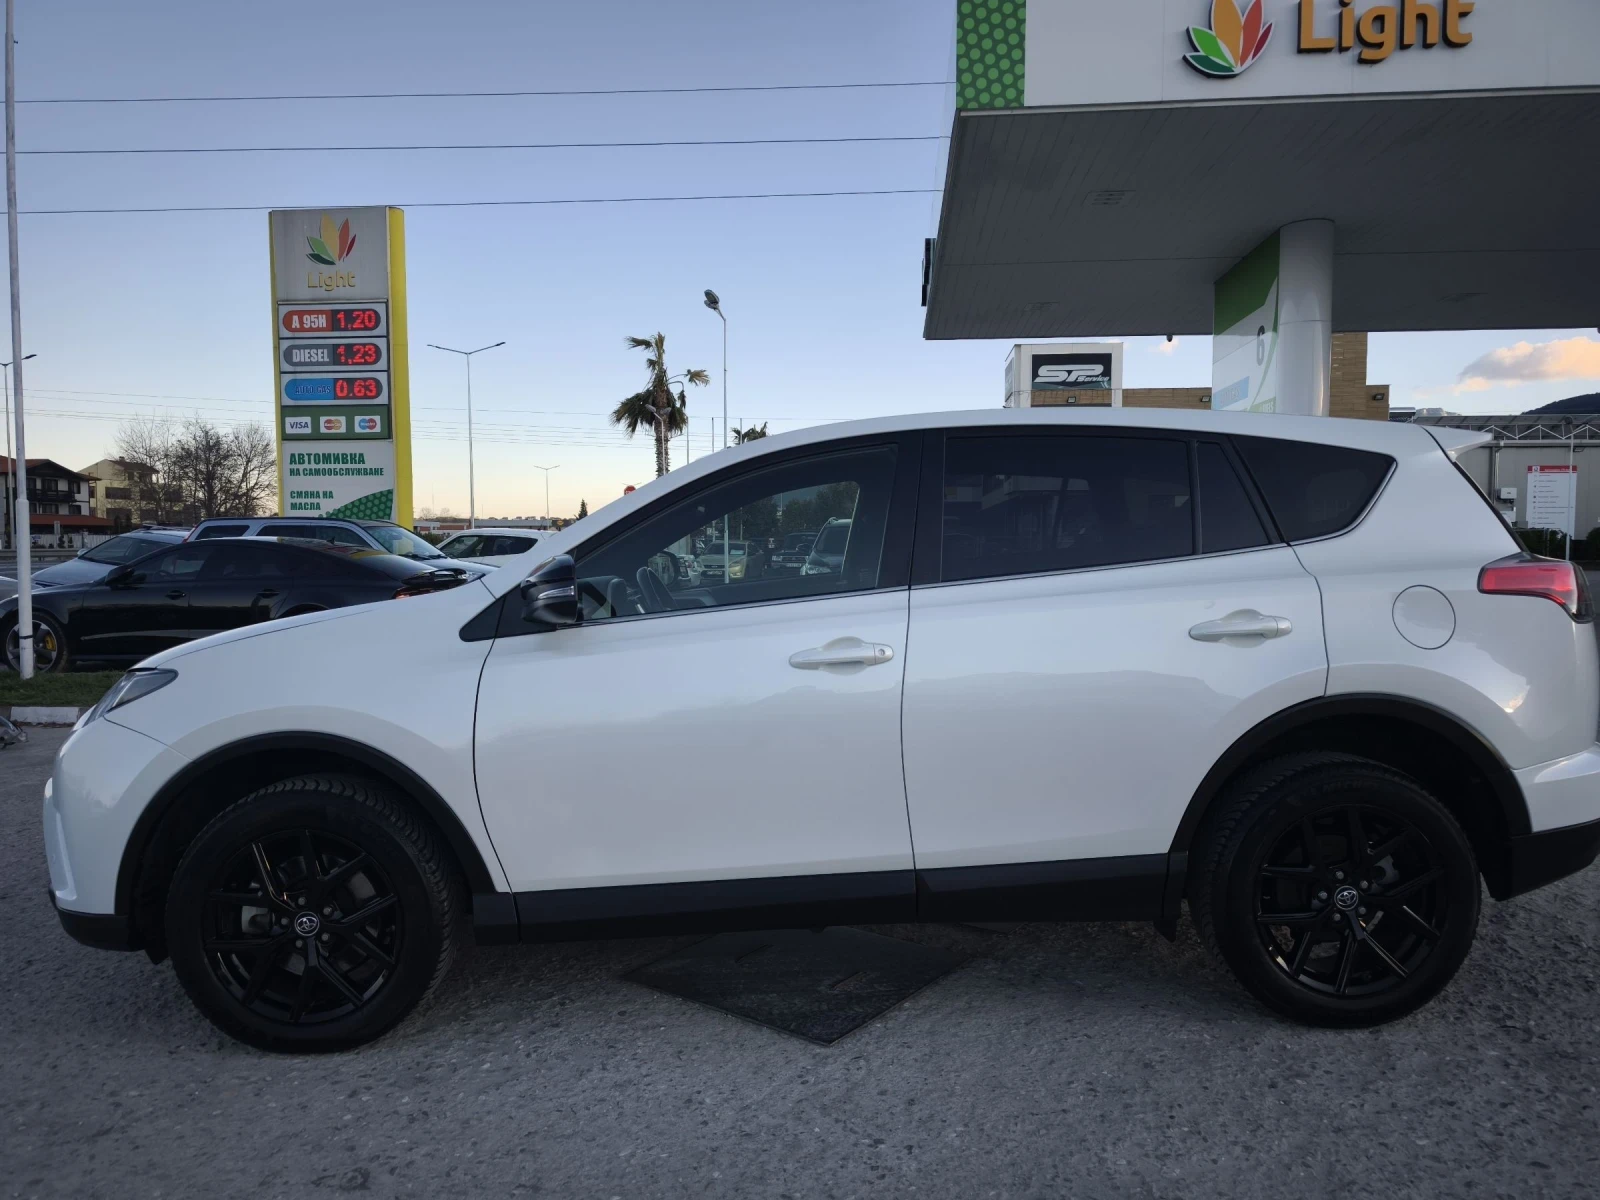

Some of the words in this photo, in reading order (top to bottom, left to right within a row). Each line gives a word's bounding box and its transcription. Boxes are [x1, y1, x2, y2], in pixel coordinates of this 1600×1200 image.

[1298, 0, 1475, 63] Light
[307, 271, 356, 291] Light
[291, 315, 300, 328] A
[1256, 325, 1265, 366] 6
[292, 348, 330, 362] DIESEL
[1033, 364, 1104, 382] SP
[289, 421, 309, 429] VISA
[289, 452, 366, 465] АВТОМИВКА
[289, 467, 301, 476] НА
[302, 467, 384, 477] САМООБСЛУЖВАНЕ
[289, 490, 321, 499] СМЯНА
[322, 490, 334, 499] НА
[290, 502, 321, 511] МАСЛА
